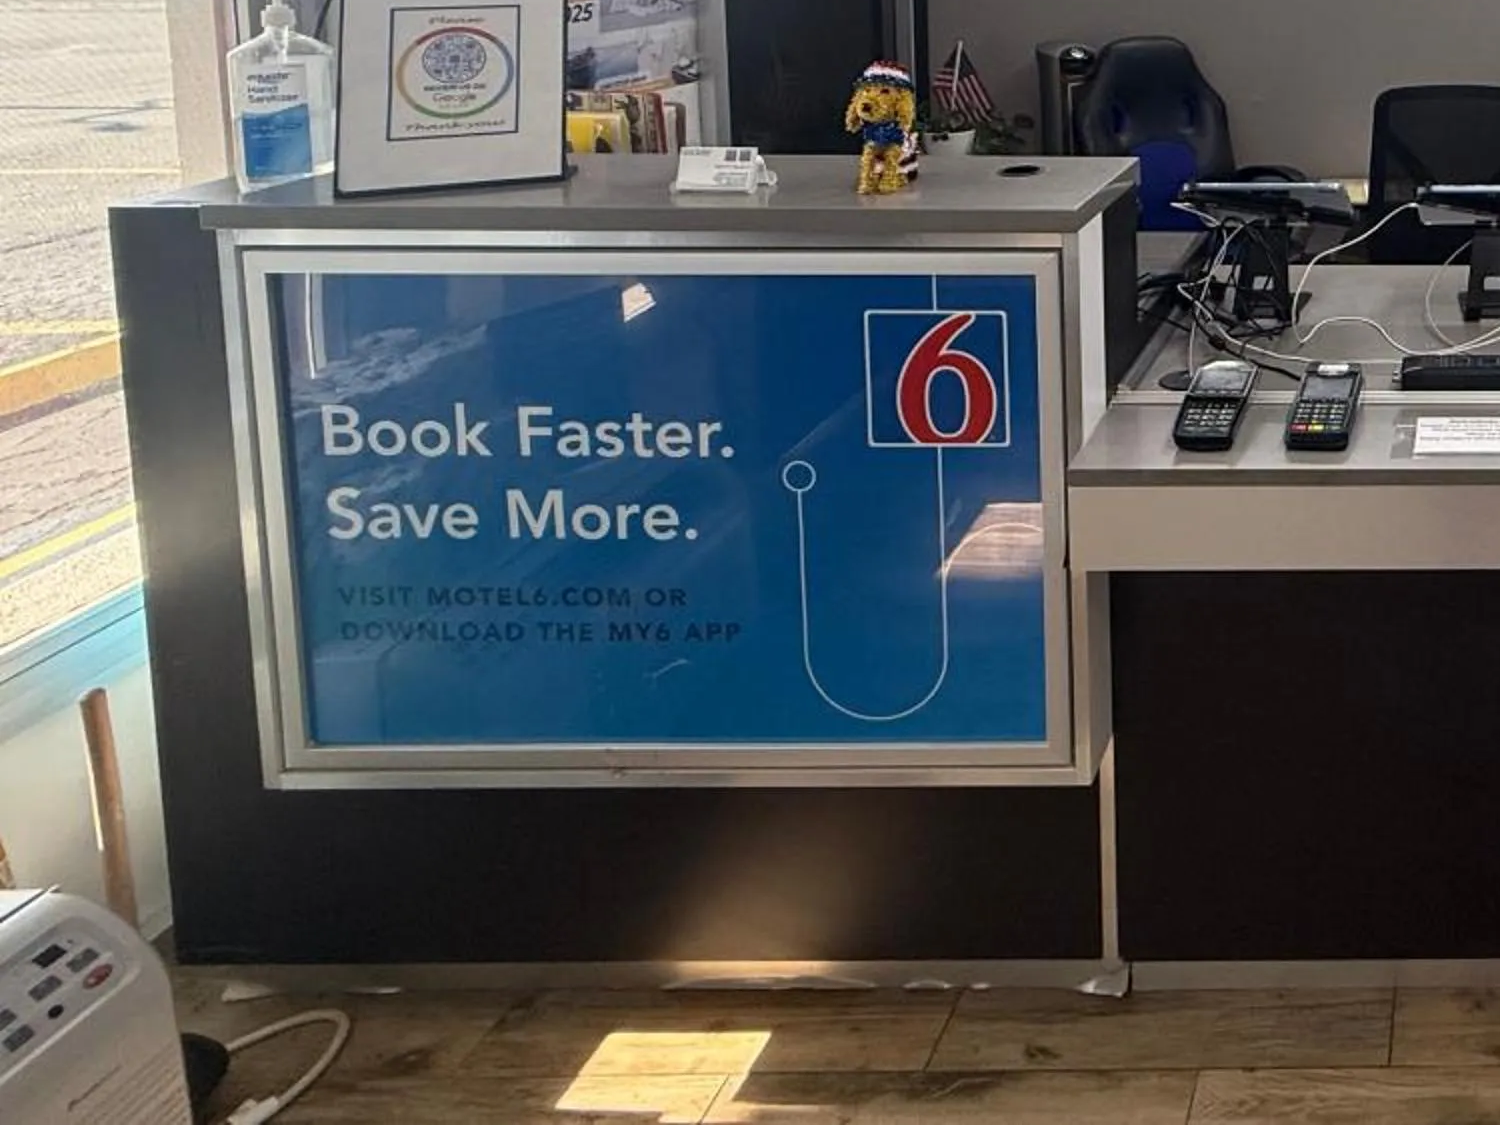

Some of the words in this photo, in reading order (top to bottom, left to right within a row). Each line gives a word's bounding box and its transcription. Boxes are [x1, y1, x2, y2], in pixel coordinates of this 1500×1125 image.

[896, 312, 998, 445] 6
[321, 401, 491, 458] Book
[517, 405, 736, 459] Faster.
[326, 487, 479, 541] Save
[506, 488, 699, 542] More.
[338, 584, 412, 608] VISIT
[426, 585, 633, 609] MOTEL6.COM
[643, 586, 688, 607] OR
[340, 620, 526, 643] DOWNLOAD
[537, 620, 595, 643] THE
[607, 620, 672, 643] MY6
[685, 620, 743, 642] APP
